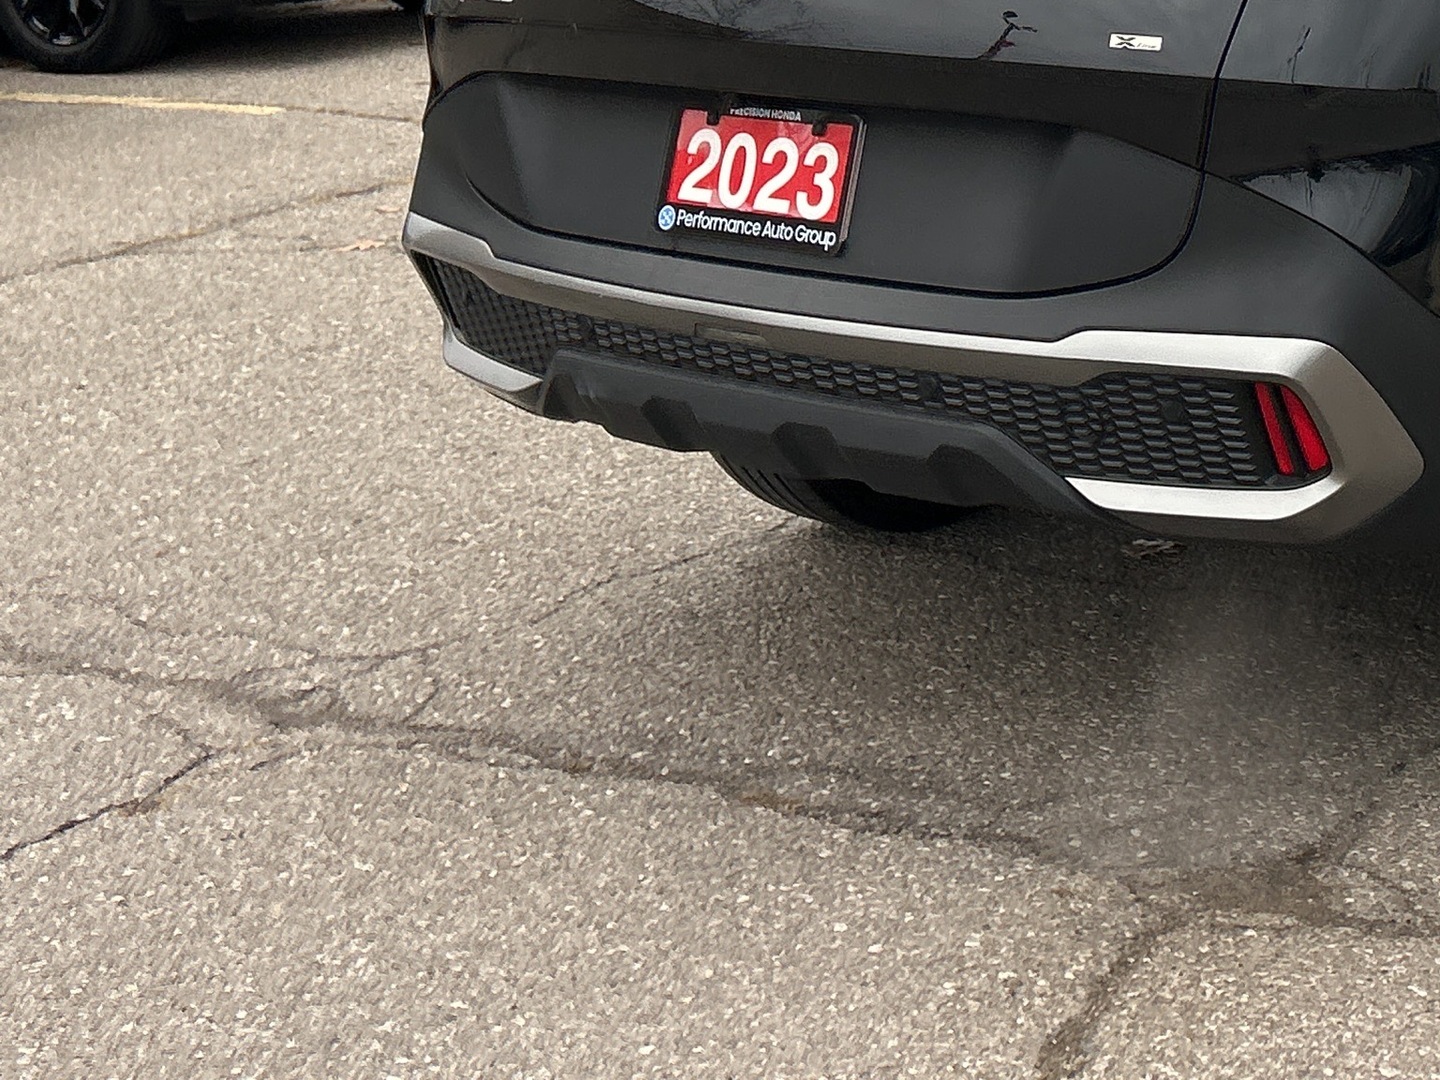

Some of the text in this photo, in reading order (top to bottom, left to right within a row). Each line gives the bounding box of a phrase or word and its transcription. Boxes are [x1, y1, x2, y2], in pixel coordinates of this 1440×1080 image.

[771, 109, 802, 121] HONDA
[677, 128, 839, 220] 2023
[676, 210, 836, 251] Performance Auto Group
